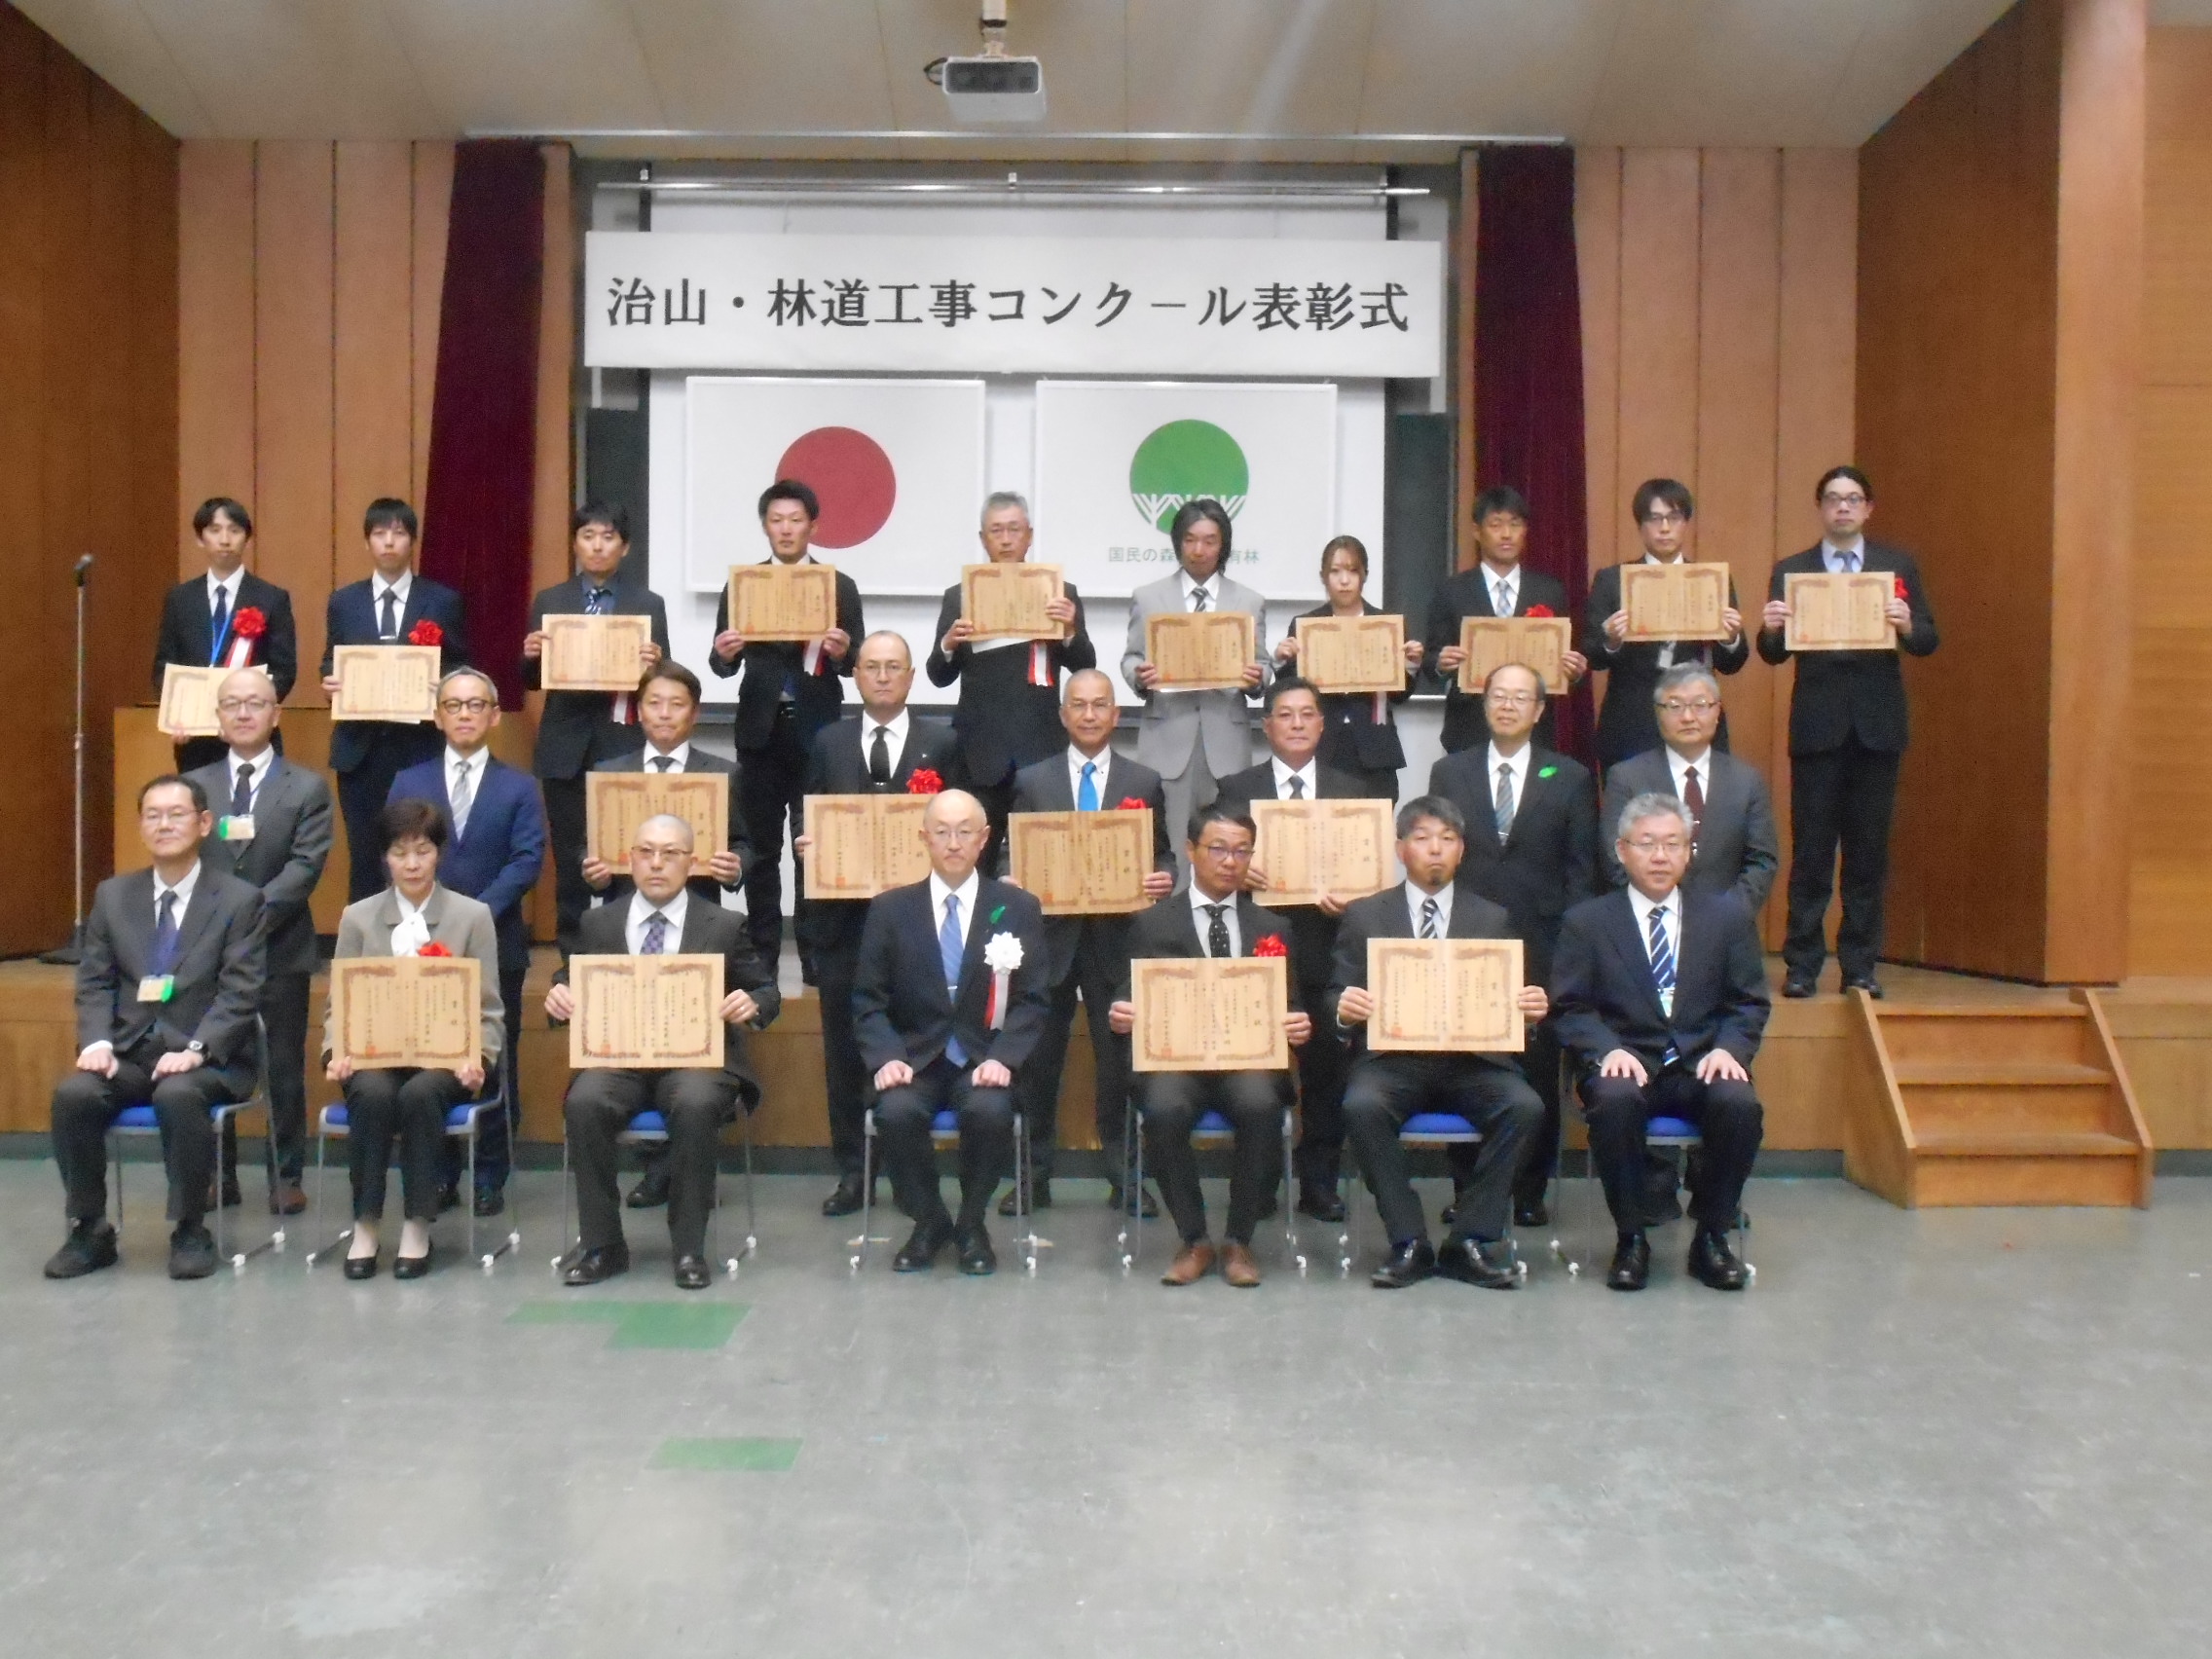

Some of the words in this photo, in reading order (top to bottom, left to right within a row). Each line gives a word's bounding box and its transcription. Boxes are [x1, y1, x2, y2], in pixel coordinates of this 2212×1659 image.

[608, 277, 1409, 332] 治山・林道工事コンクール表彰式
